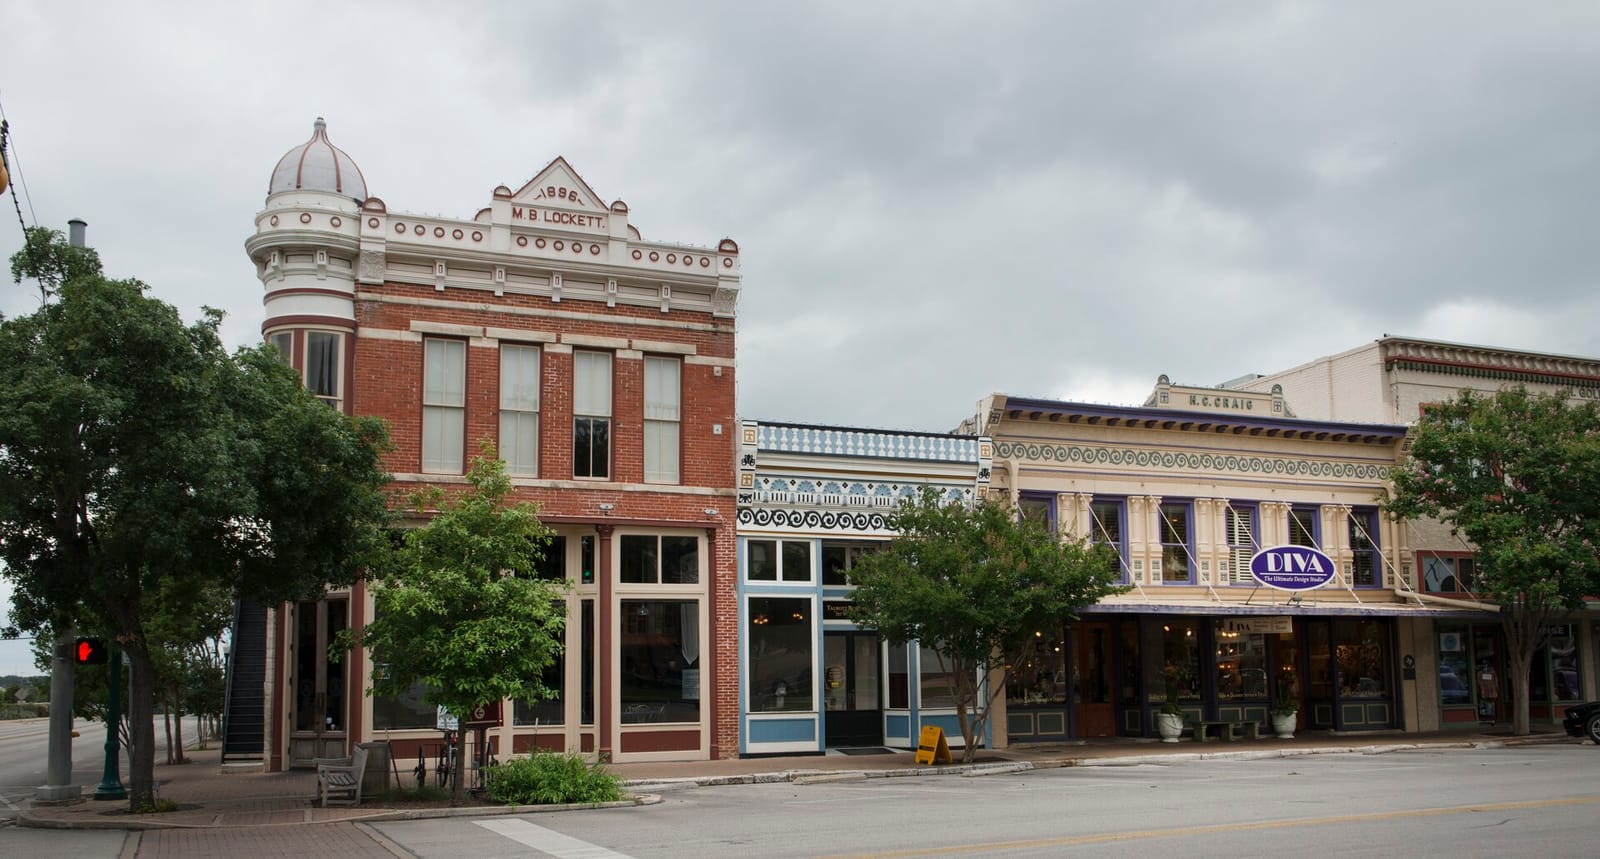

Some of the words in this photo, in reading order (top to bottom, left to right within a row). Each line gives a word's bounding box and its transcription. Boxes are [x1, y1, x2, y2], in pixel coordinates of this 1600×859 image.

[540, 186, 578, 202] 1896
[544, 210, 605, 229] LOCKETT.
[1579, 386, 1600, 399] GOL
[1214, 398, 1253, 410] CRAIG
[1266, 552, 1324, 573] DIVA
[1294, 576, 1309, 584] Design
